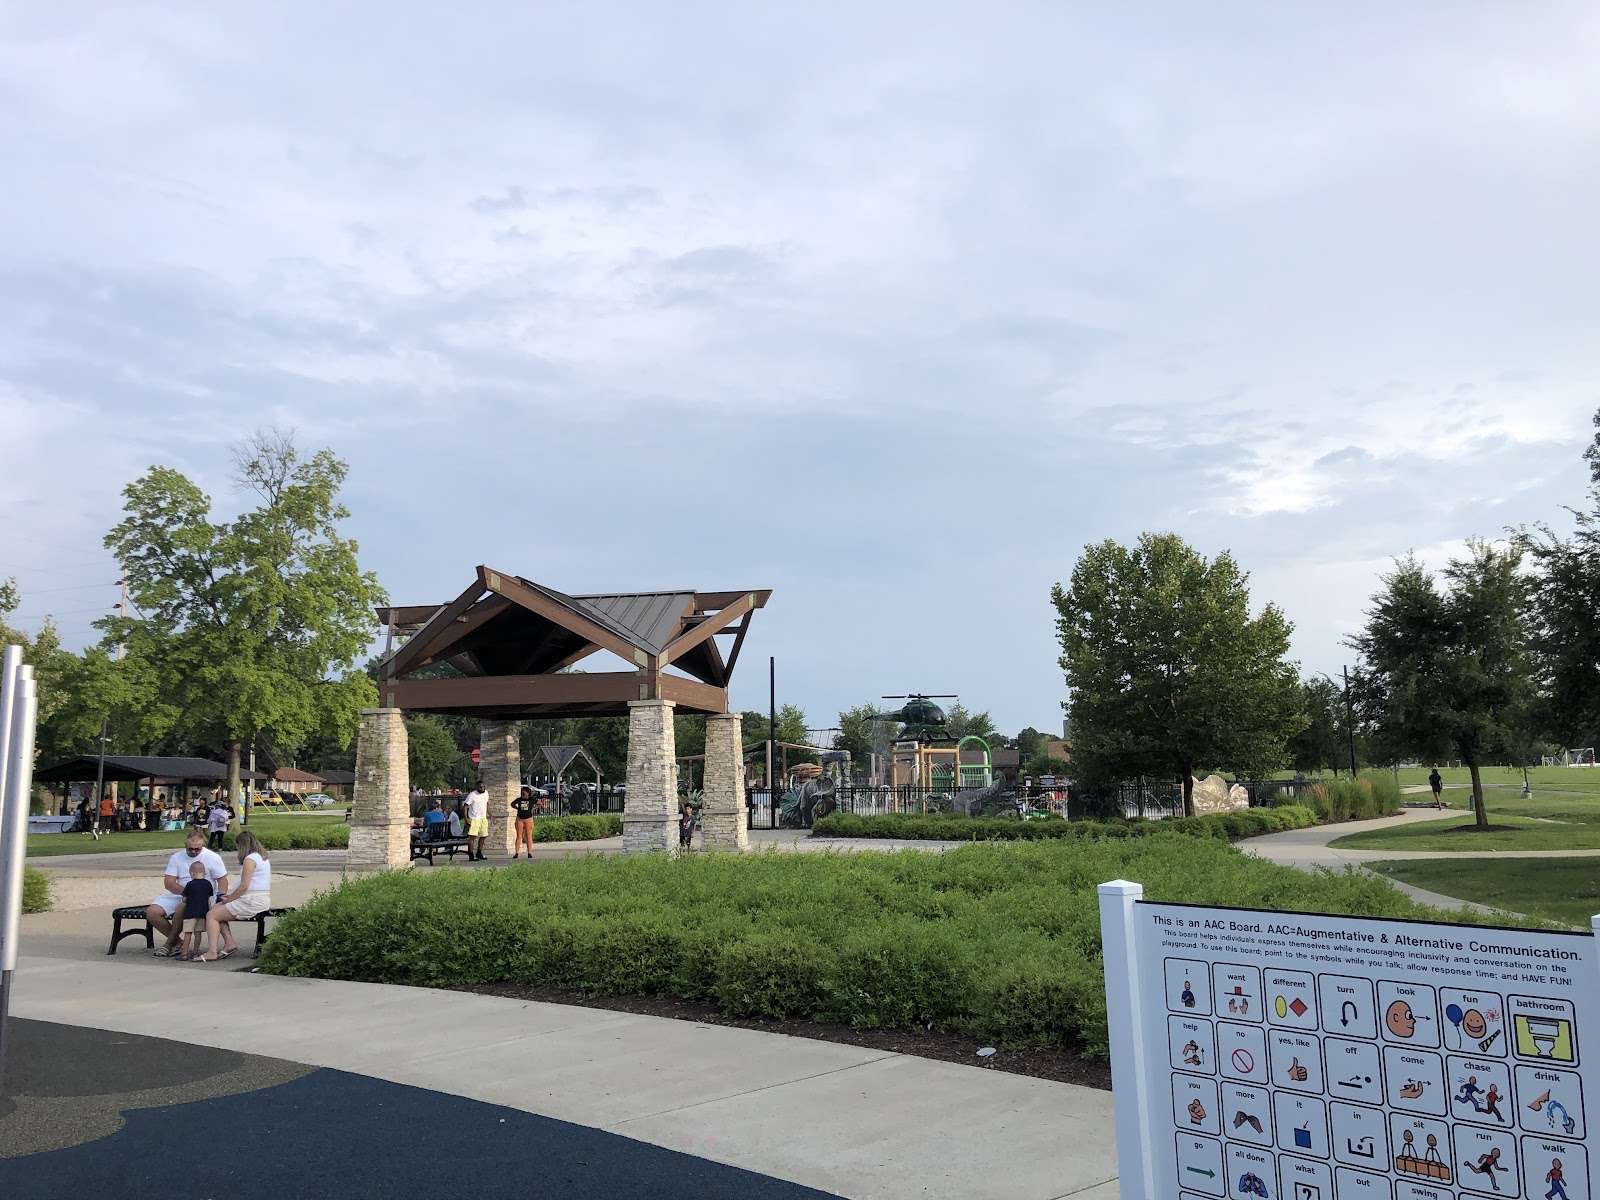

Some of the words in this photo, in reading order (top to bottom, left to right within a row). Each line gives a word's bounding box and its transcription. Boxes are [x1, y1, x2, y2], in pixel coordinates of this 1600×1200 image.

[1152, 915, 1172, 926] This
[1175, 918, 1184, 927] is
[1188, 920, 1200, 928] an
[1204, 920, 1226, 930] AAC
[1229, 921, 1263, 933] Board.
[1267, 924, 1375, 943] AAC=Augmentative
[1380, 933, 1389, 944] &
[1394, 934, 1463, 951] Alternative
[1469, 941, 1582, 961] Communication.
[1163, 929, 1177, 937] This
[1179, 930, 1198, 939] board
[1199, 932, 1218, 941] helps
[1219, 933, 1255, 944] individuals
[1288, 940, 1331, 950] themselves
[1356, 947, 1405, 959] encouraging
[1408, 951, 1450, 963] inclusivity
[1453, 955, 1470, 964] and
[1473, 957, 1532, 970] conversation
[1551, 964, 1567, 973] the
[1161, 940, 1199, 949] playground.
[1225, 945, 1238, 953] this
[1240, 947, 1262, 956] board;
[1310, 953, 1342, 963] symbols
[1385, 960, 1403, 970] talk;
[1406, 963, 1428, 972] allow
[1431, 966, 1472, 977] response
[1475, 969, 1498, 980] time;
[1501, 973, 1518, 981] and
[1521, 974, 1546, 983] HAVE
[1550, 976, 1572, 986] FUN!
[1227, 974, 1246, 982] want
[1272, 978, 1306, 989] different
[1336, 985, 1355, 994] turn
[1396, 986, 1416, 996] look
[1462, 994, 1479, 1004] fun
[1516, 999, 1565, 1012] bathroom
[1182, 1022, 1199, 1031] help
[1235, 1030, 1246, 1038] no
[1278, 1036, 1294, 1046] yes,
[1295, 1038, 1310, 1048] like
[1345, 1046, 1358, 1055] off
[1400, 1055, 1425, 1065] come
[1463, 1061, 1491, 1073] chase
[1534, 1072, 1561, 1083] drink
[1187, 1081, 1201, 1090] you
[1235, 1090, 1256, 1100] more
[1296, 1101, 1303, 1109] it
[1353, 1112, 1362, 1120] in
[1413, 1120, 1425, 1129] sit
[1475, 1132, 1493, 1141] run
[1194, 1142, 1203, 1150] go
[1541, 1143, 1566, 1154] walk
[1235, 1150, 1245, 1159] all
[1245, 1153, 1266, 1163] done
[1294, 1164, 1316, 1175] what
[1355, 1178, 1371, 1187] out
[1411, 1187, 1438, 1200] swing
